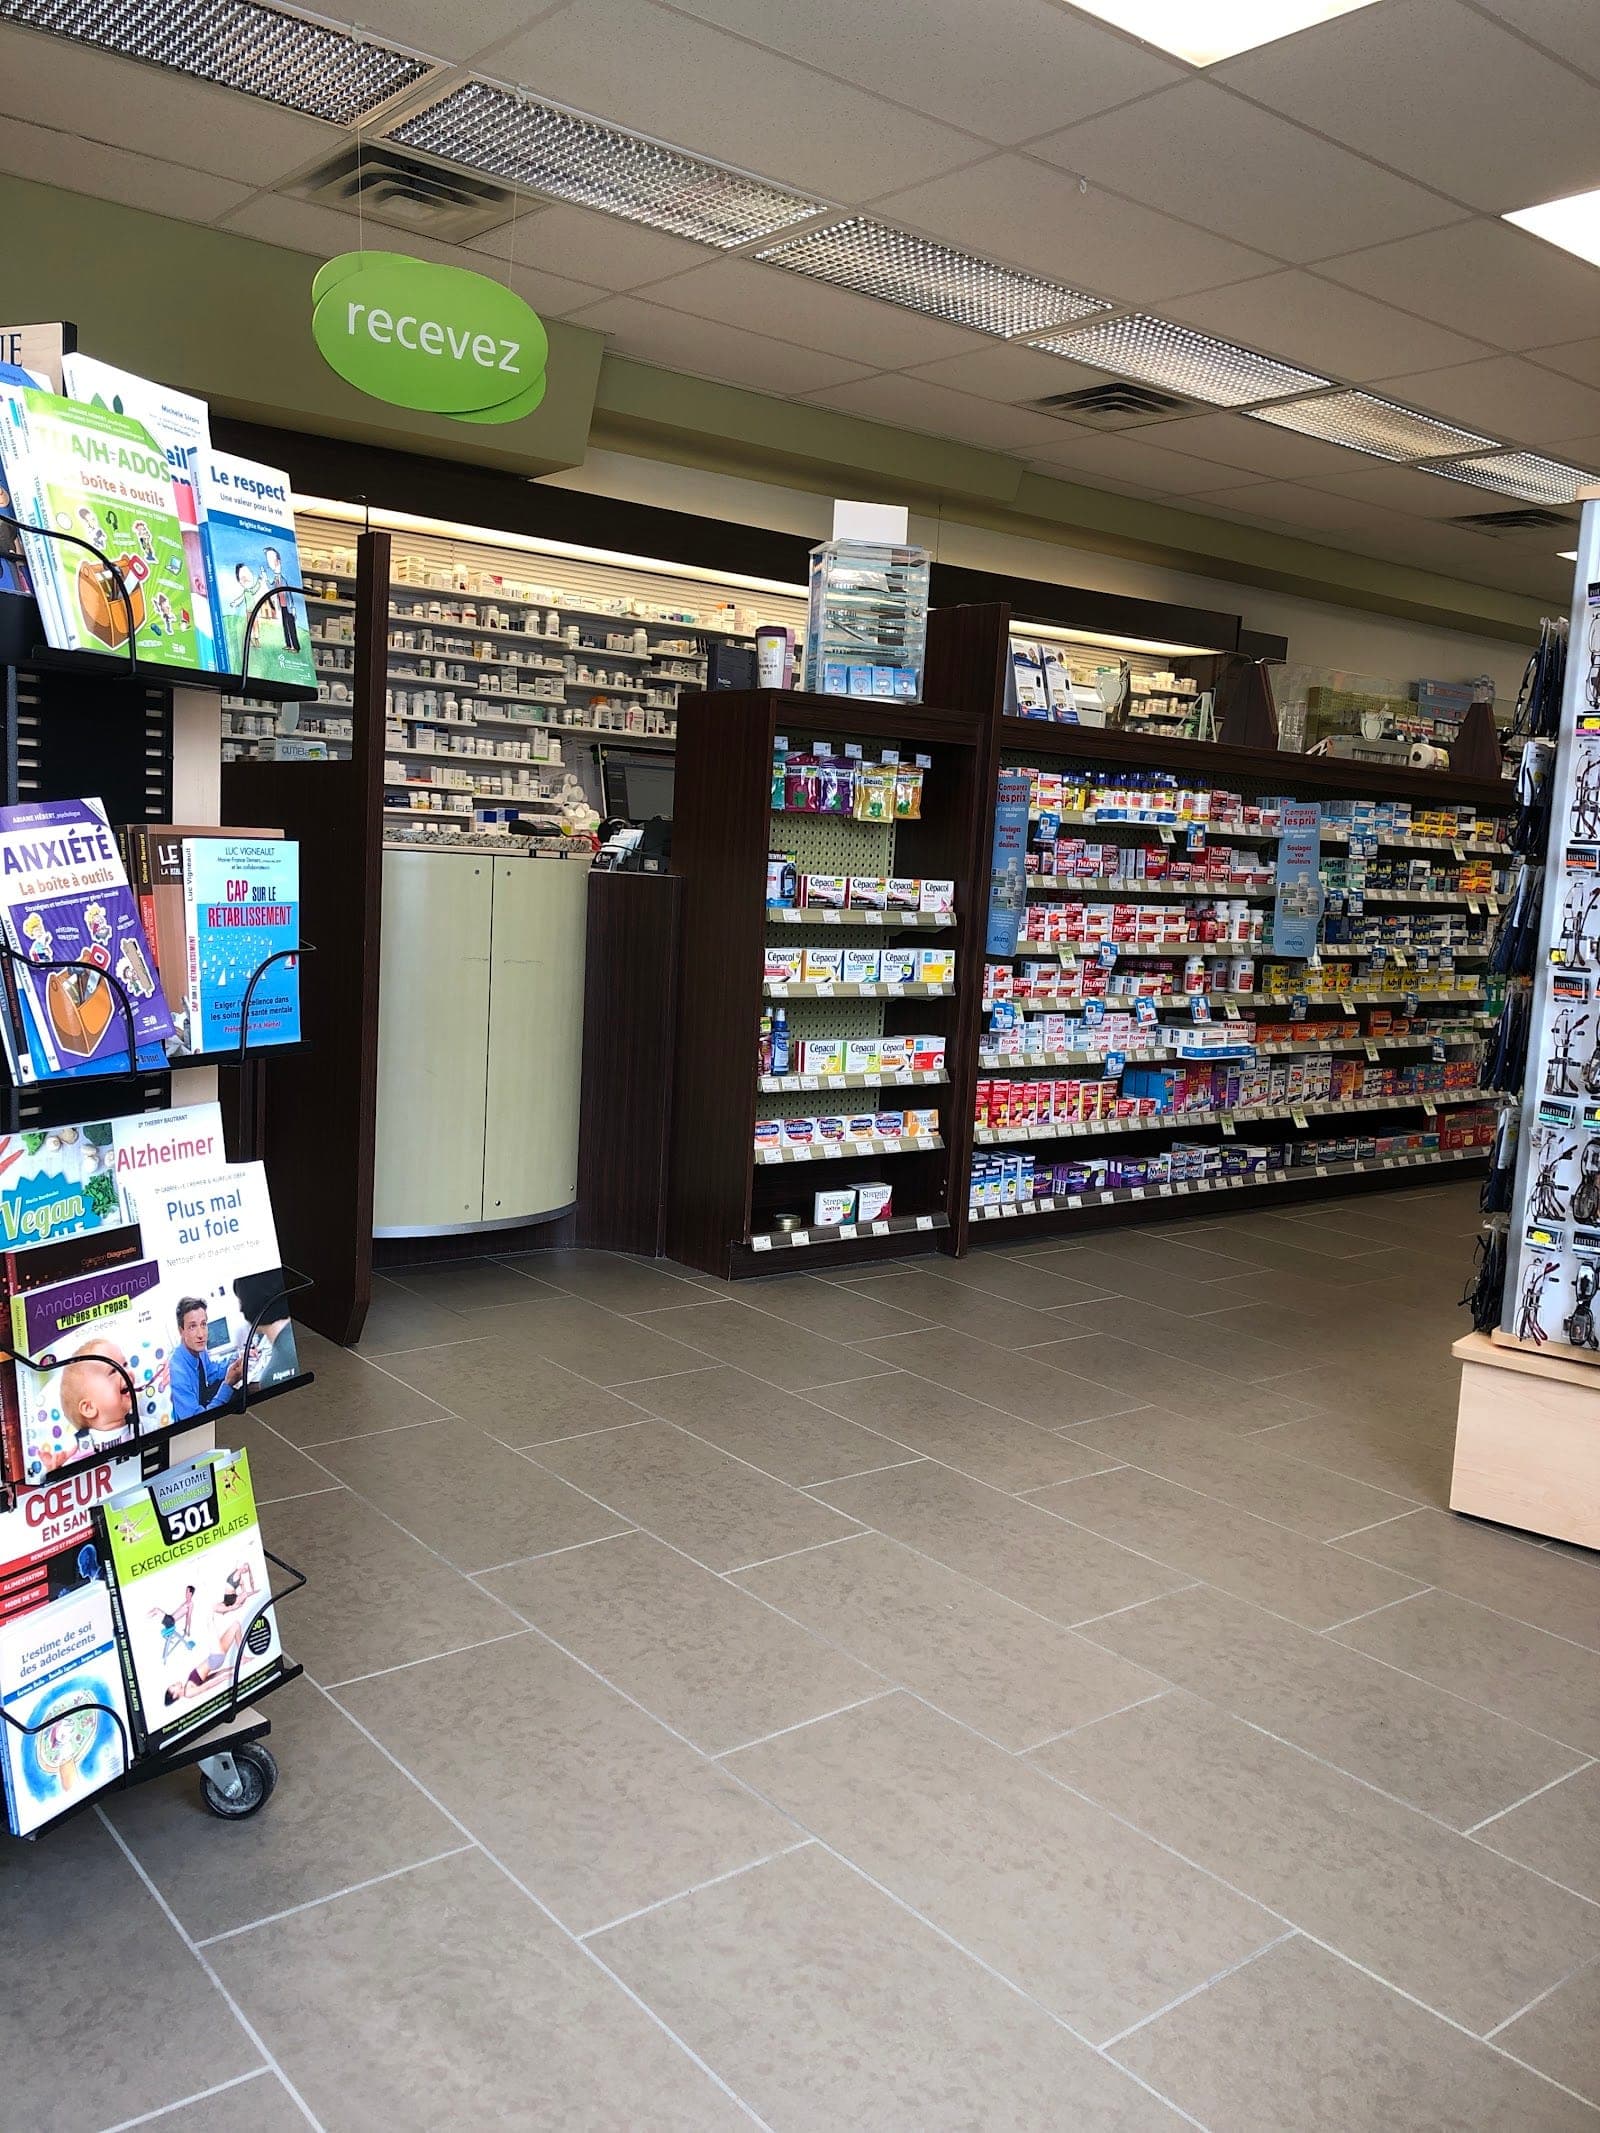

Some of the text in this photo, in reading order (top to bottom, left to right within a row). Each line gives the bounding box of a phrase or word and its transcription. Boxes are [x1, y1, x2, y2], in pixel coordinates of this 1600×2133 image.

[348, 302, 520, 374] recevez
[118, 447, 171, 484] ADOS
[80, 471, 117, 493] boîte
[119, 481, 127, 496] à
[130, 488, 165, 508] outils
[210, 465, 230, 485] Le
[233, 475, 287, 502] respect
[220, 492, 284, 517] Une valeur pour la vie
[998, 783, 1028, 792] Comparez
[1010, 793, 1026, 805] prix
[1284, 808, 1317, 827] Comparez les prix
[3, 824, 113, 875] ANXIÉTÉ
[158, 844, 179, 866] LE
[225, 847, 276, 856] LUC VIGNEAULT
[19, 867, 114, 896] La boîte à outils
[186, 847, 194, 890] Vigneault
[226, 879, 277, 902] CAP SUR LE
[810, 876, 834, 889] Cépaco
[889, 879, 913, 892] Cépacol
[925, 882, 950, 893] Cépacol
[208, 901, 292, 928] RÉTABLISSEMENT
[767, 951, 911, 964] Cépacol Cépacol Cépacol Cépacol
[211, 1005, 293, 1021] les soins santé mentale
[214, 996, 289, 1010] Exiger l'ecellence dans
[810, 1042, 905, 1054] Cépacol Cépacol Cépacol
[144, 1118, 163, 1127] THIERRY
[117, 1136, 214, 1173] Alzheimer
[0, 1193, 85, 1242] Vegan
[167, 1188, 242, 1222] Plus mal
[178, 1216, 240, 1244] au foie
[34, 1271, 152, 1320] Annabel Karmel
[92, 1299, 128, 1317] et repas
[25, 1463, 113, 1528] CŒUR
[159, 1470, 209, 1497] ANATOMIE
[42, 1509, 89, 1543] EN SAN
[167, 1501, 214, 1541] 501
[130, 1513, 250, 1577] EXERCICES DE PILATES
[3, 1569, 45, 1591] ALIMENTATION
[4, 1590, 41, 1609] MODE DE VIE
[19, 1663, 37, 1678] des
[39, 1632, 97, 1668] adolescents
[21, 1621, 93, 1664] L'estime de soi
